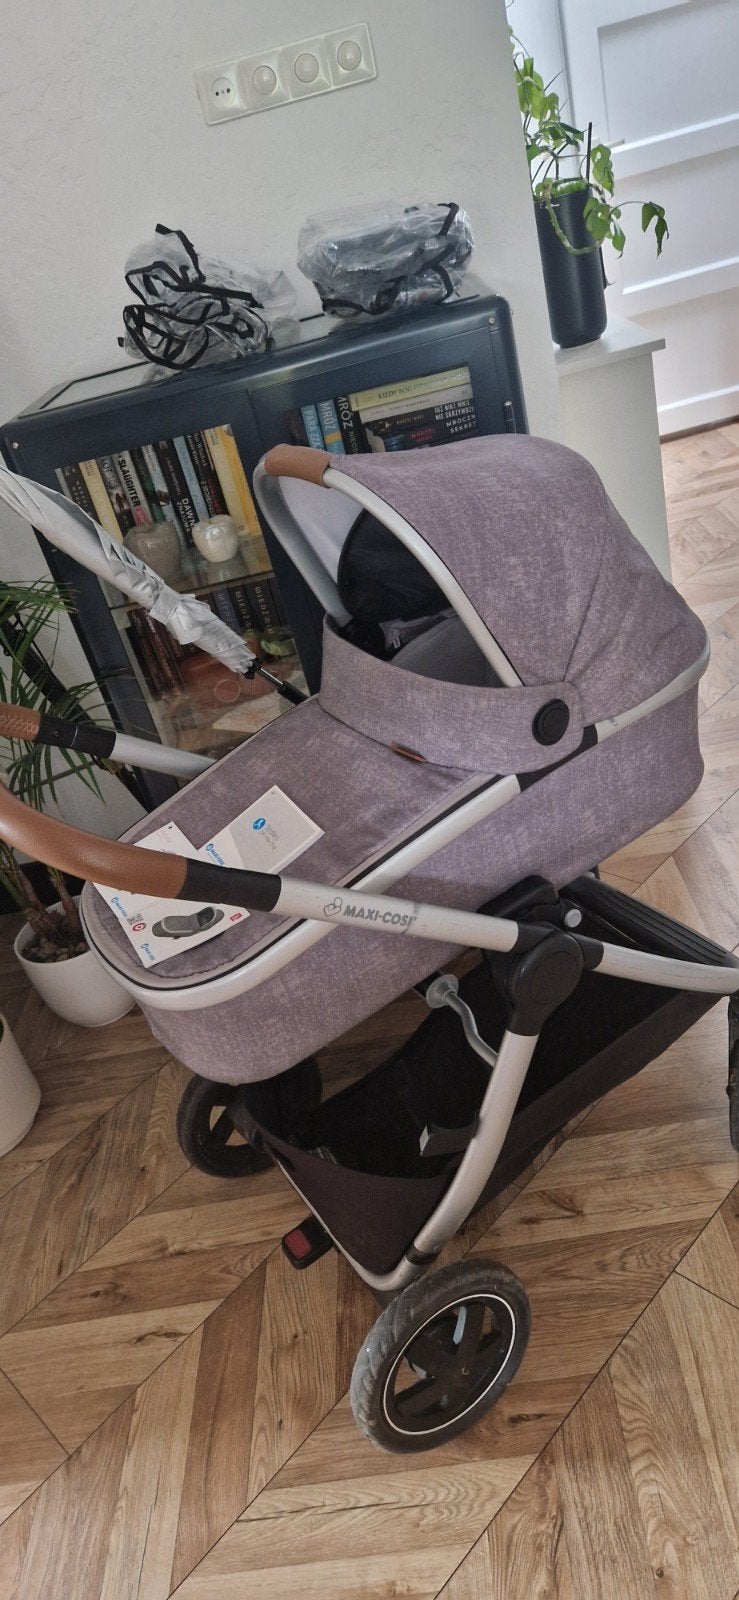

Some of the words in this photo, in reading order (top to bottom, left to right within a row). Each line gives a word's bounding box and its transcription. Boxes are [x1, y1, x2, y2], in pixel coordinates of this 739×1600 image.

[378, 389, 397, 400] KIEDY
[304, 409, 317, 432] PARA
[320, 401, 336, 431] MRÓZ
[118, 459, 141, 507] SLAUGHTER
[176, 502, 191, 533] ZNAJOMA
[181, 498, 196, 528] DAWN
[343, 904, 414, 927] MAXI-COSI
